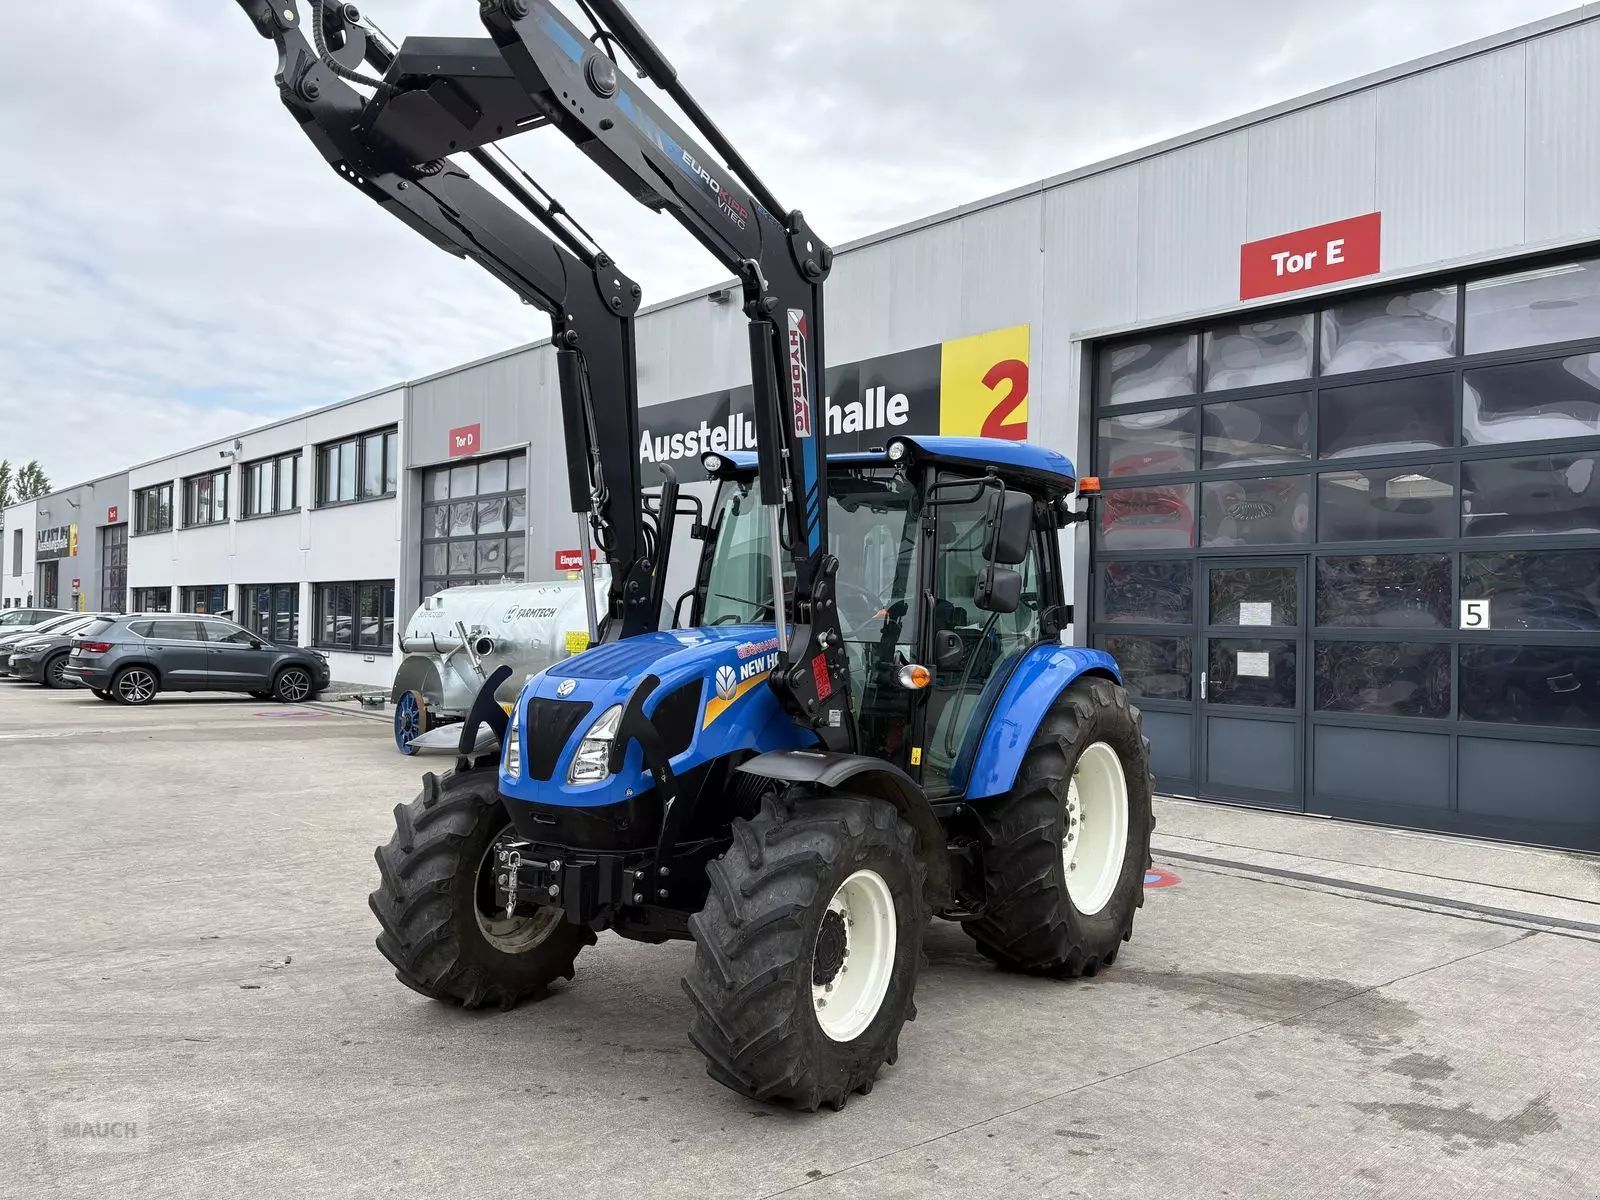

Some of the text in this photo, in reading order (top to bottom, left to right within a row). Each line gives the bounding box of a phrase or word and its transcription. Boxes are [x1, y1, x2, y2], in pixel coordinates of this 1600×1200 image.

[682, 150, 749, 221] EUROKIPP
[717, 196, 746, 230] VITEC
[1270, 238, 1345, 277] Tor E
[790, 330, 804, 432] HYDRAC
[980, 359, 1028, 441] 2
[455, 433, 474, 448] Tor D
[516, 607, 557, 620] FARMTECH
[1466, 603, 1482, 626] 5
[740, 657, 765, 681] NEW
